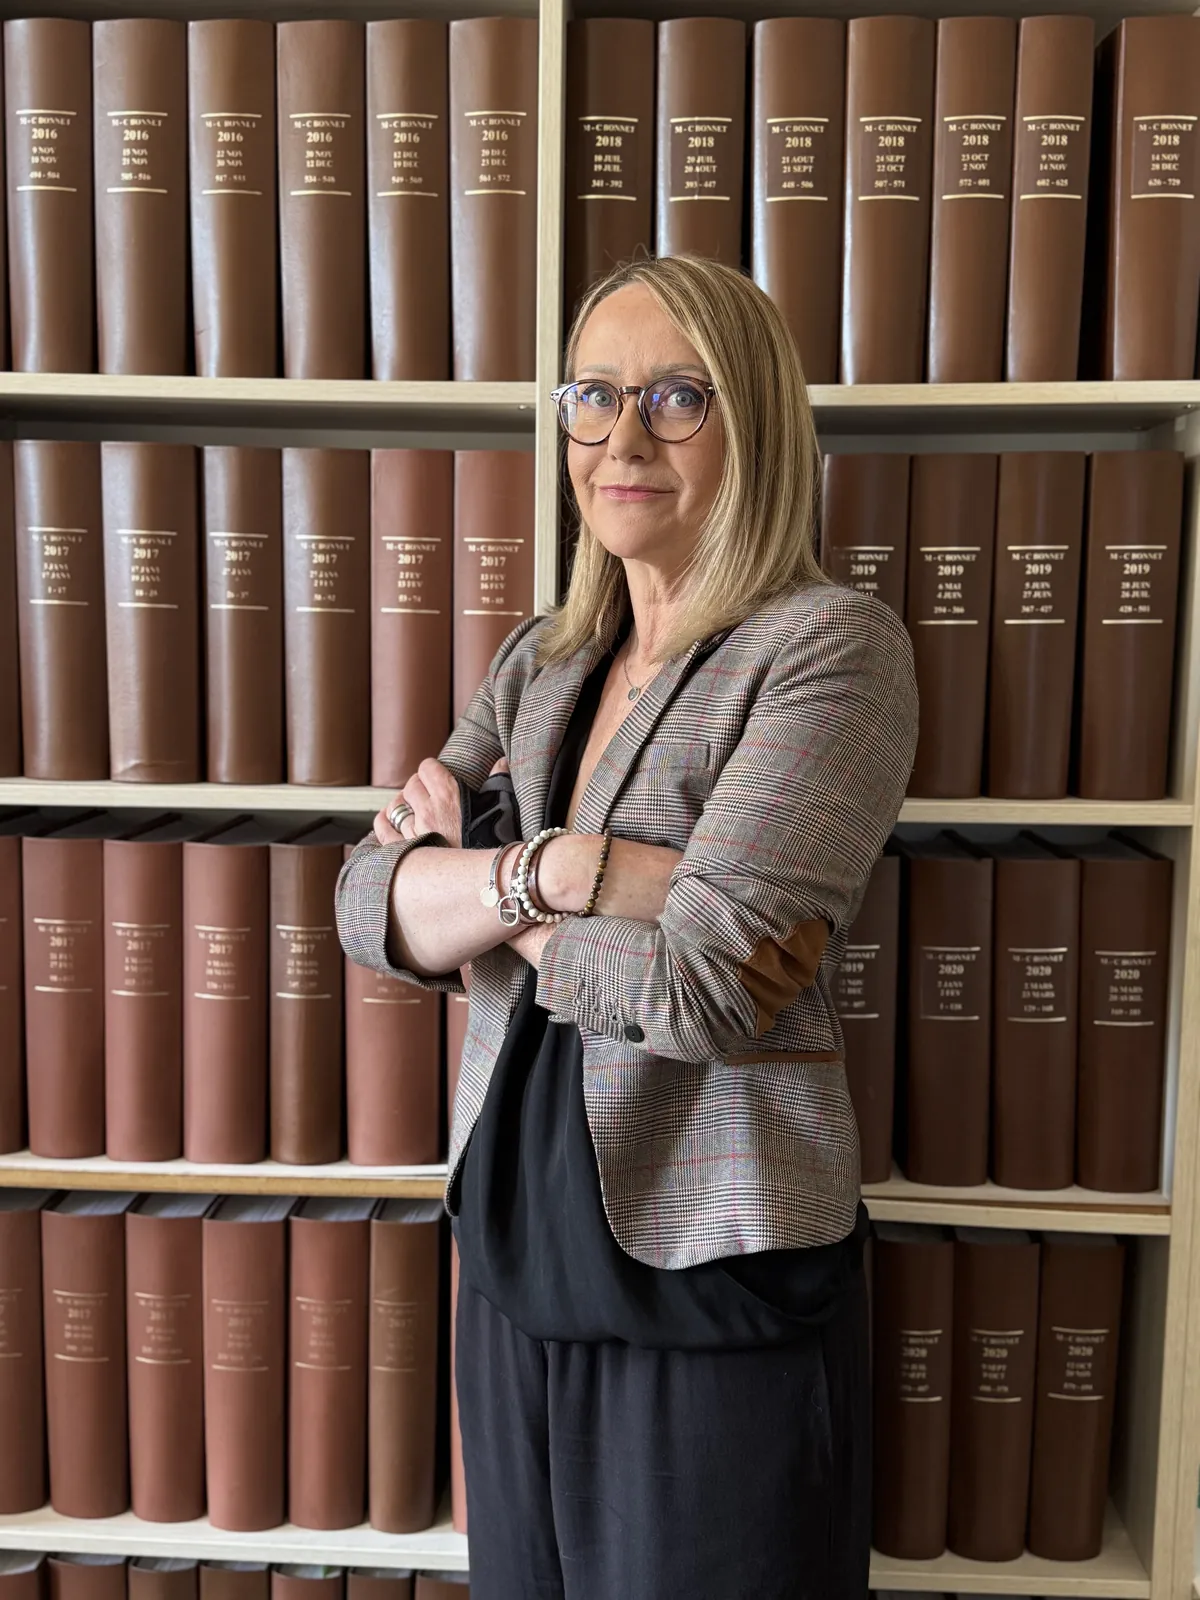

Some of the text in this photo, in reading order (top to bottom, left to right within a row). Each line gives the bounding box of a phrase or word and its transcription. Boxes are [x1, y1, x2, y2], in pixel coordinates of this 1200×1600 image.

[603, 125, 635, 133] BONNET
[886, 124, 917, 132] BONNET
[32, 129, 57, 139] 2016
[124, 130, 149, 140] 2016
[218, 132, 243, 142] 2016
[307, 132, 332, 142] 2016
[394, 132, 420, 143] 2016
[482, 131, 508, 141] 2016
[596, 136, 622, 147] 2018
[688, 137, 714, 147] 2018
[786, 137, 812, 147] 2018
[879, 136, 904, 146] 2018
[963, 135, 989, 146] 2018
[1041, 135, 1068, 146] 2018
[1153, 135, 1179, 145] 2018
[694, 165, 717, 173] AOUT
[793, 165, 813, 173] SEPT
[44, 546, 69, 556] 2017
[134, 549, 159, 558] 2017
[225, 551, 250, 561] 2017
[312, 554, 337, 564] 2017
[398, 554, 423, 564] 2017
[480, 556, 506, 566] 2017
[851, 565, 876, 575] 2019
[938, 565, 964, 575] 2019
[1026, 564, 1052, 574] 2019
[1124, 564, 1150, 574] 2019
[50, 936, 74, 947] 2017
[126, 941, 151, 951] 2017
[209, 944, 232, 954] 2017
[290, 944, 315, 954] 2017
[840, 962, 864, 972] 2019
[939, 964, 964, 974] 2020
[1026, 966, 1052, 976] 2020
[1114, 969, 1140, 979] 2020
[983, 1348, 1008, 1358] 2020
[1068, 1346, 1093, 1356] 2020
